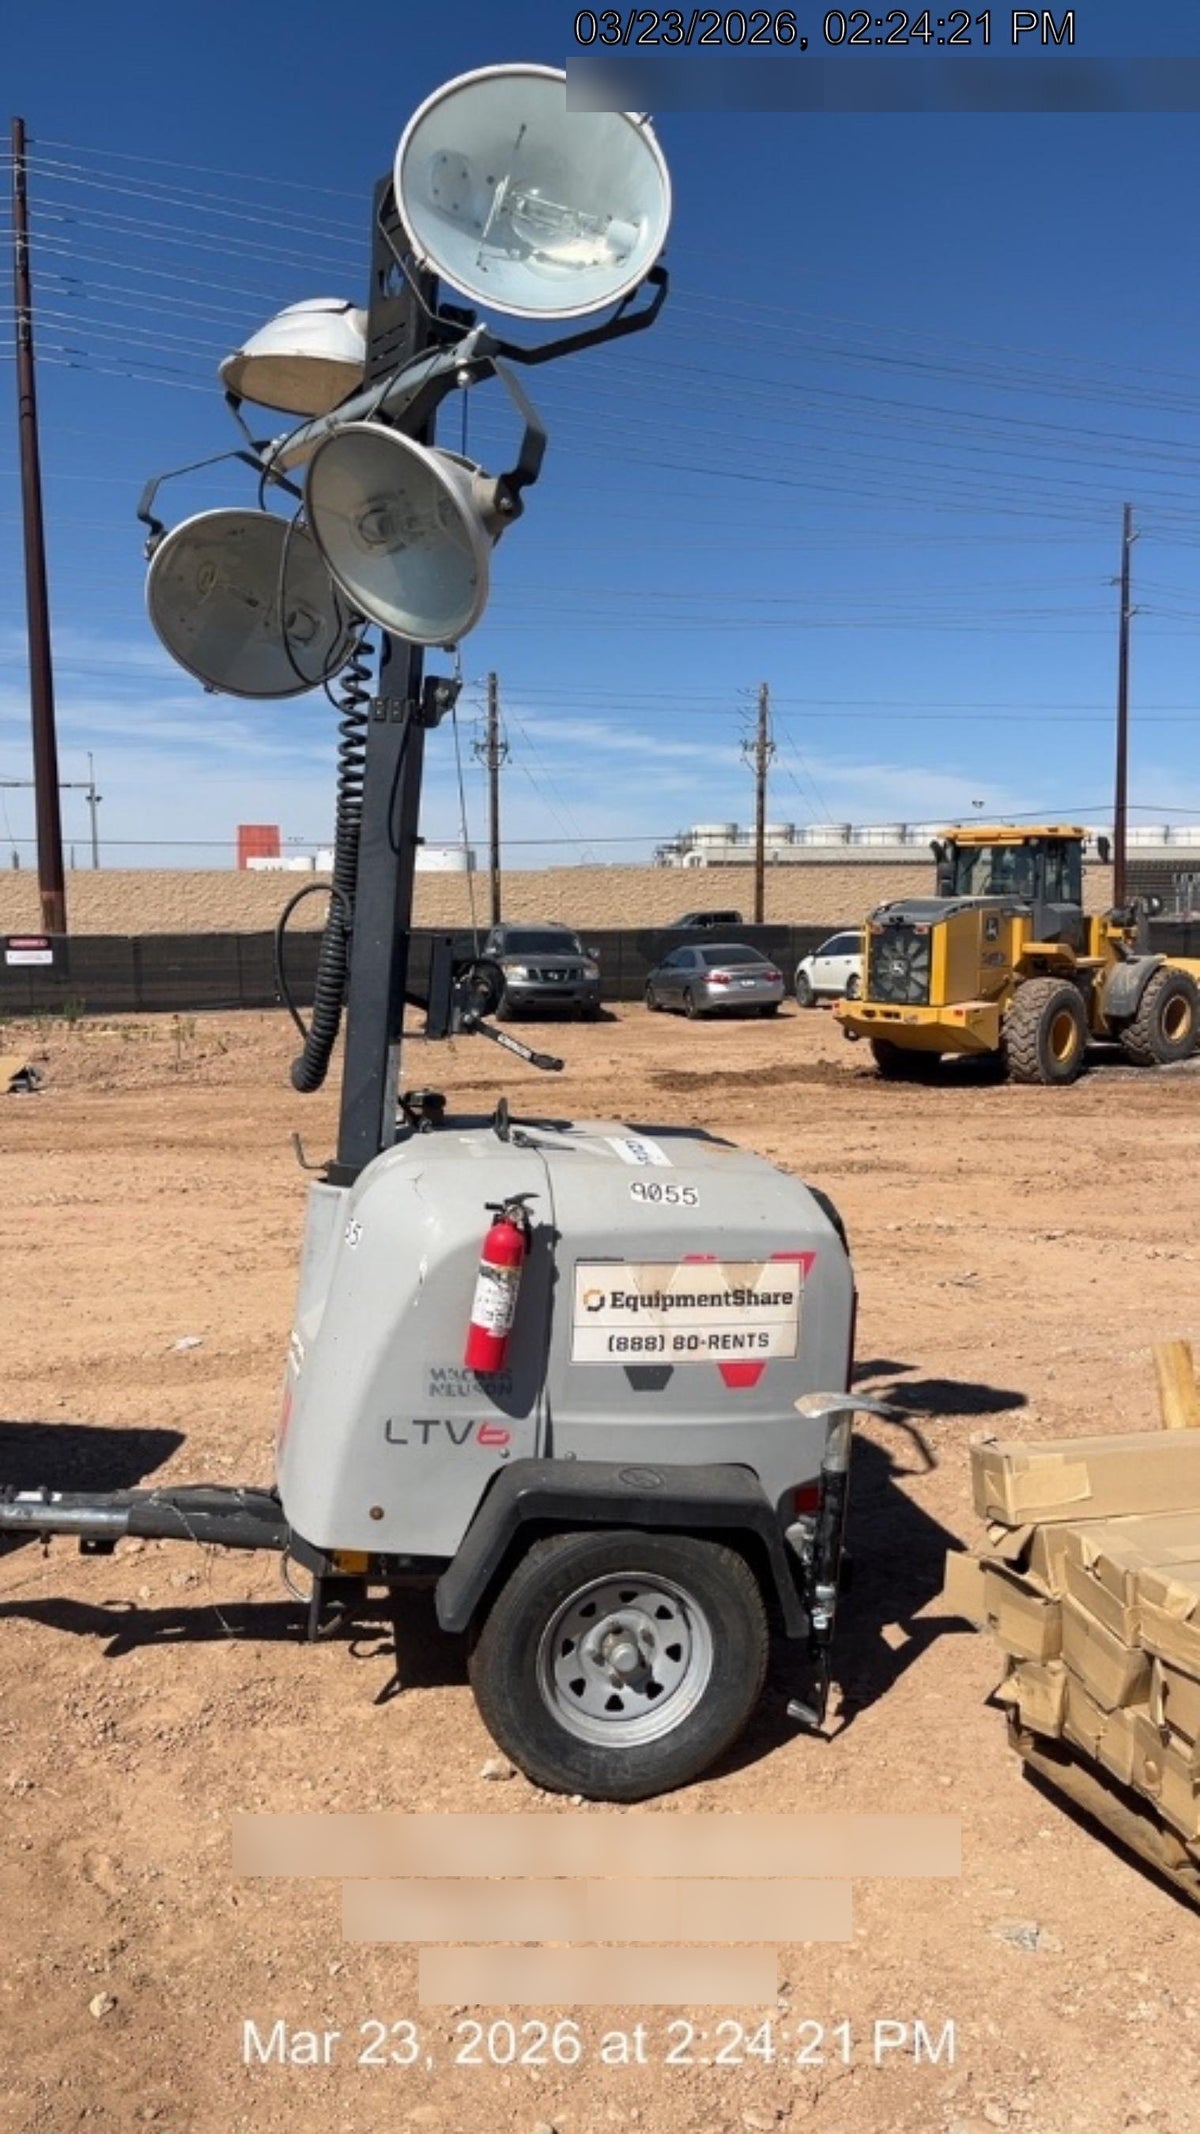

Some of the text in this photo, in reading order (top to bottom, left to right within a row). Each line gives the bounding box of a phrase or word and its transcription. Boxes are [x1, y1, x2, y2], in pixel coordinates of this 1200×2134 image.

[630, 1182, 698, 1206] 9055
[609, 1289, 793, 1312] EquipmentShare
[607, 1332, 770, 1352] (888) 80-RENTS
[384, 1418, 511, 1446] LTV6
